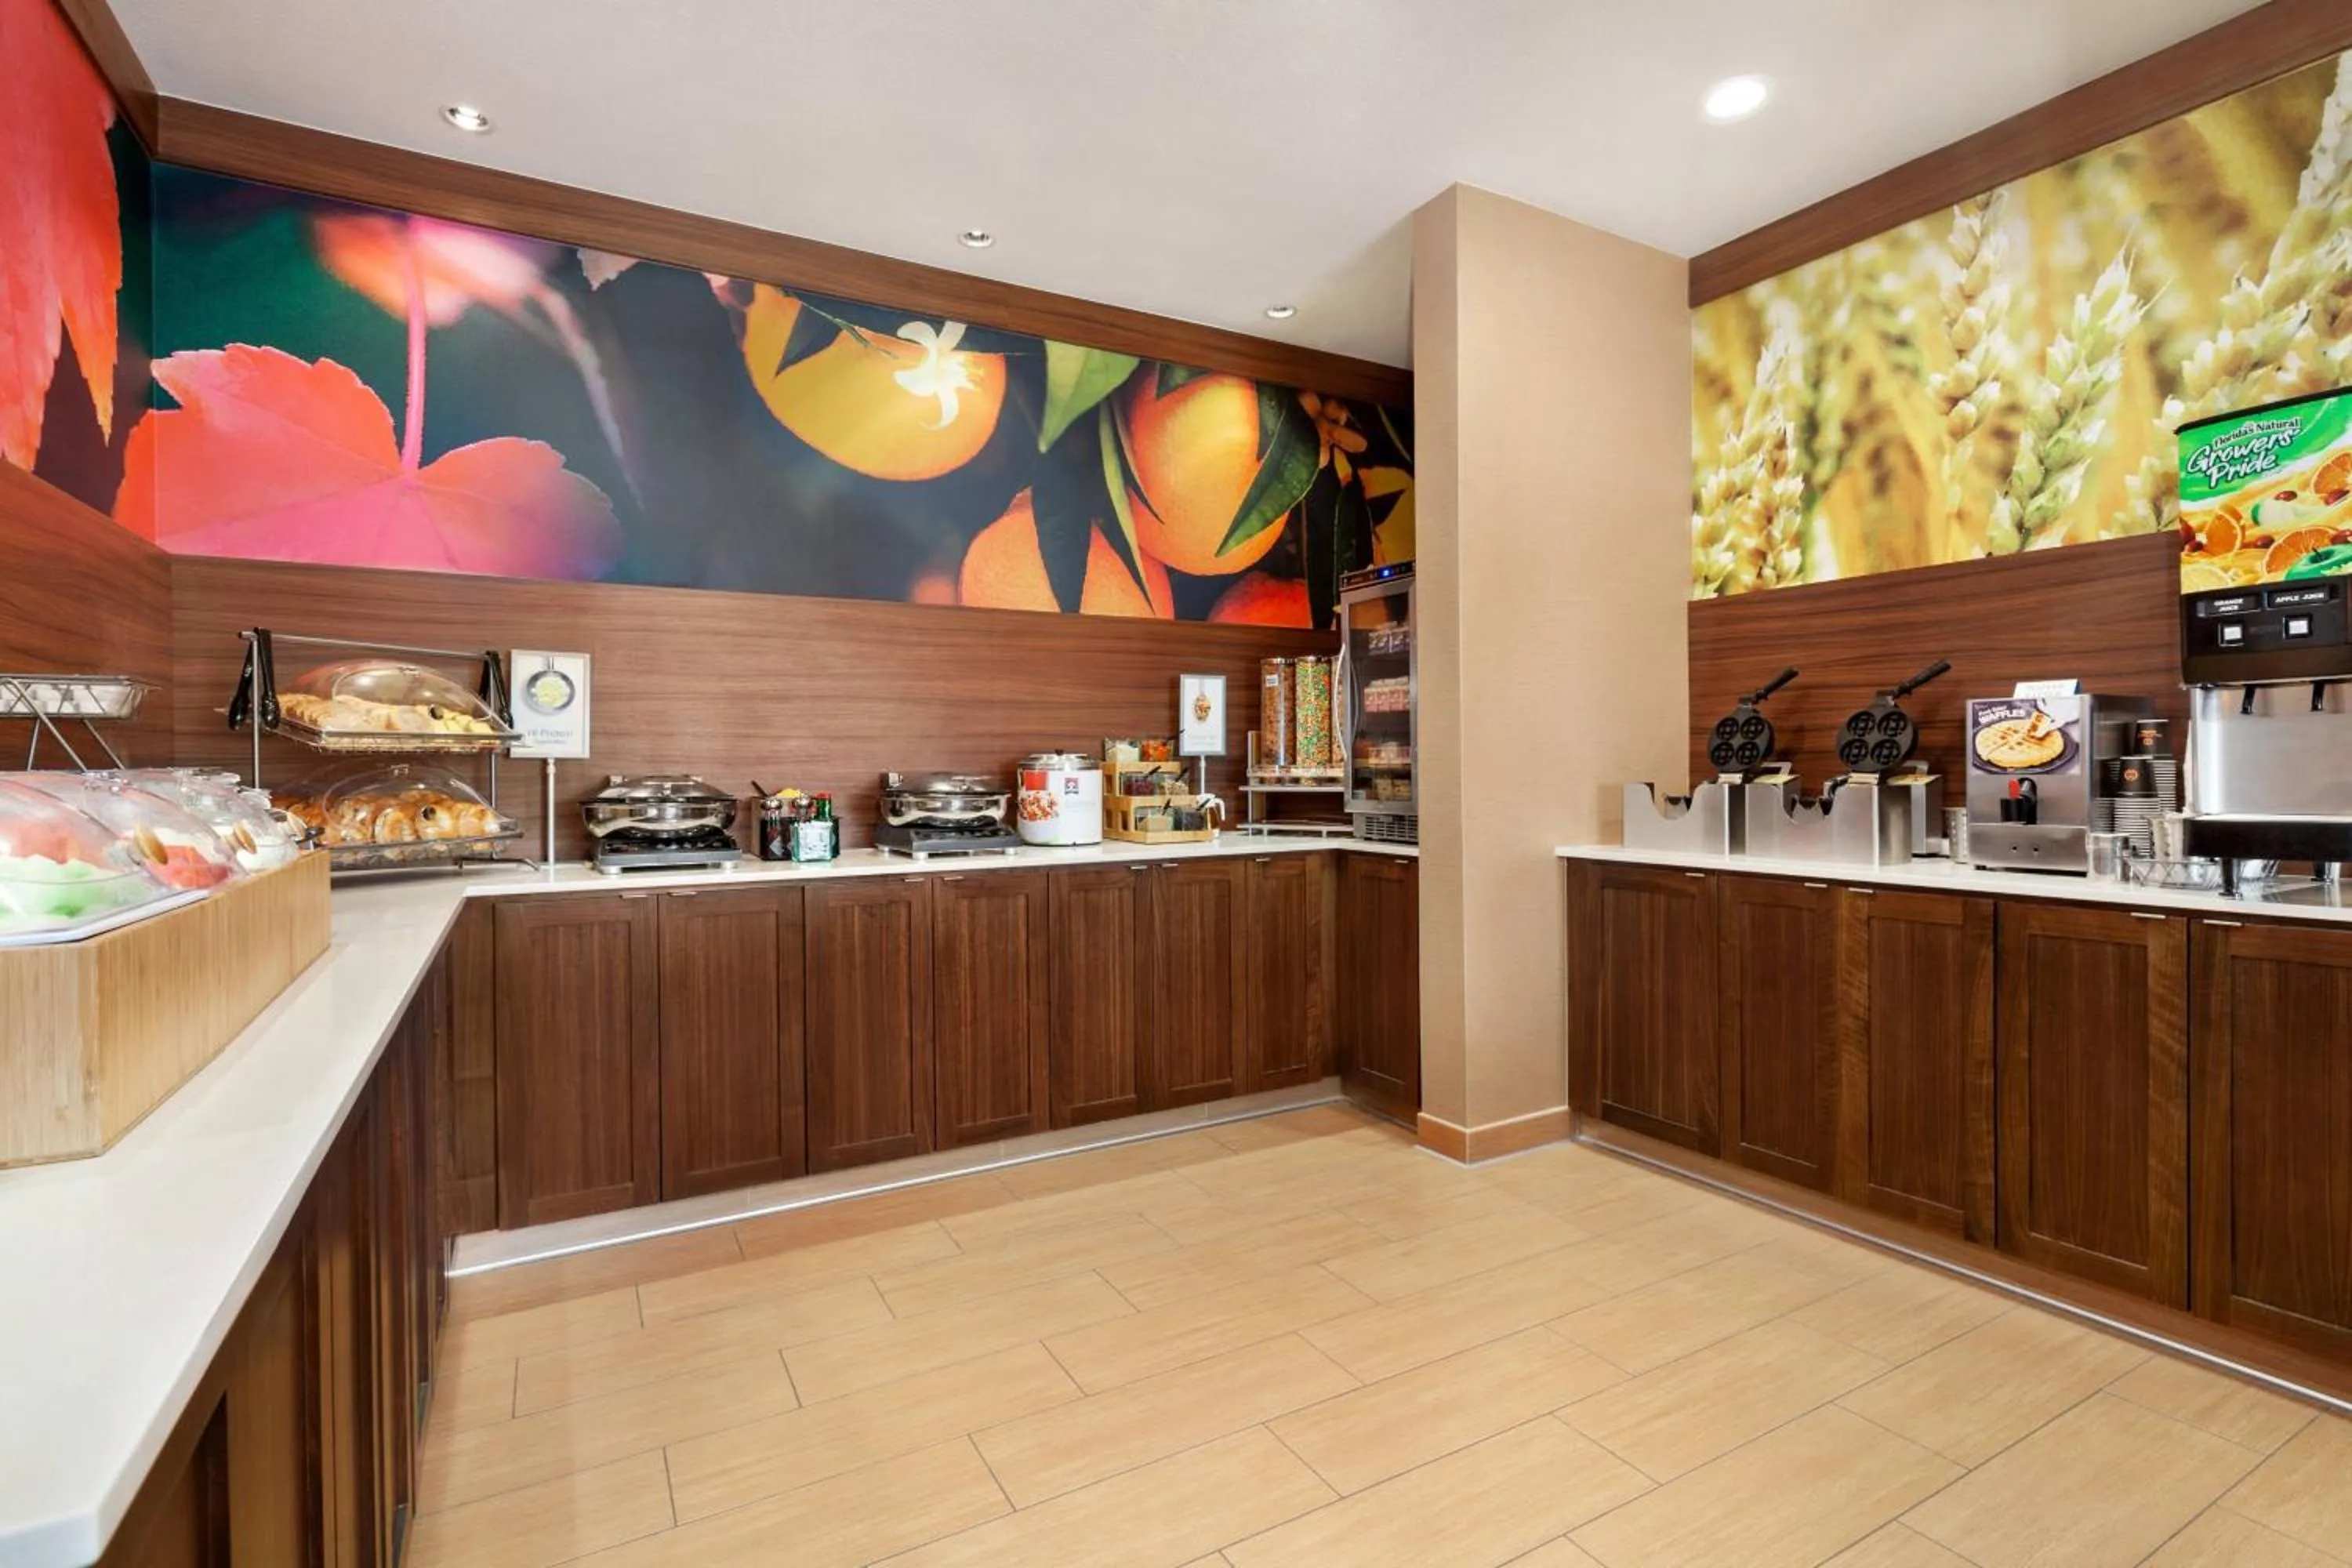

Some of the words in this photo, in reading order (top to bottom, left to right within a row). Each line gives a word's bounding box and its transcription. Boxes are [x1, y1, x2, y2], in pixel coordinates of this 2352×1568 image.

[2256, 418, 2299, 431] Natural
[2205, 450, 2278, 488] Pride
[1978, 708, 2026, 724] WAFFLES
